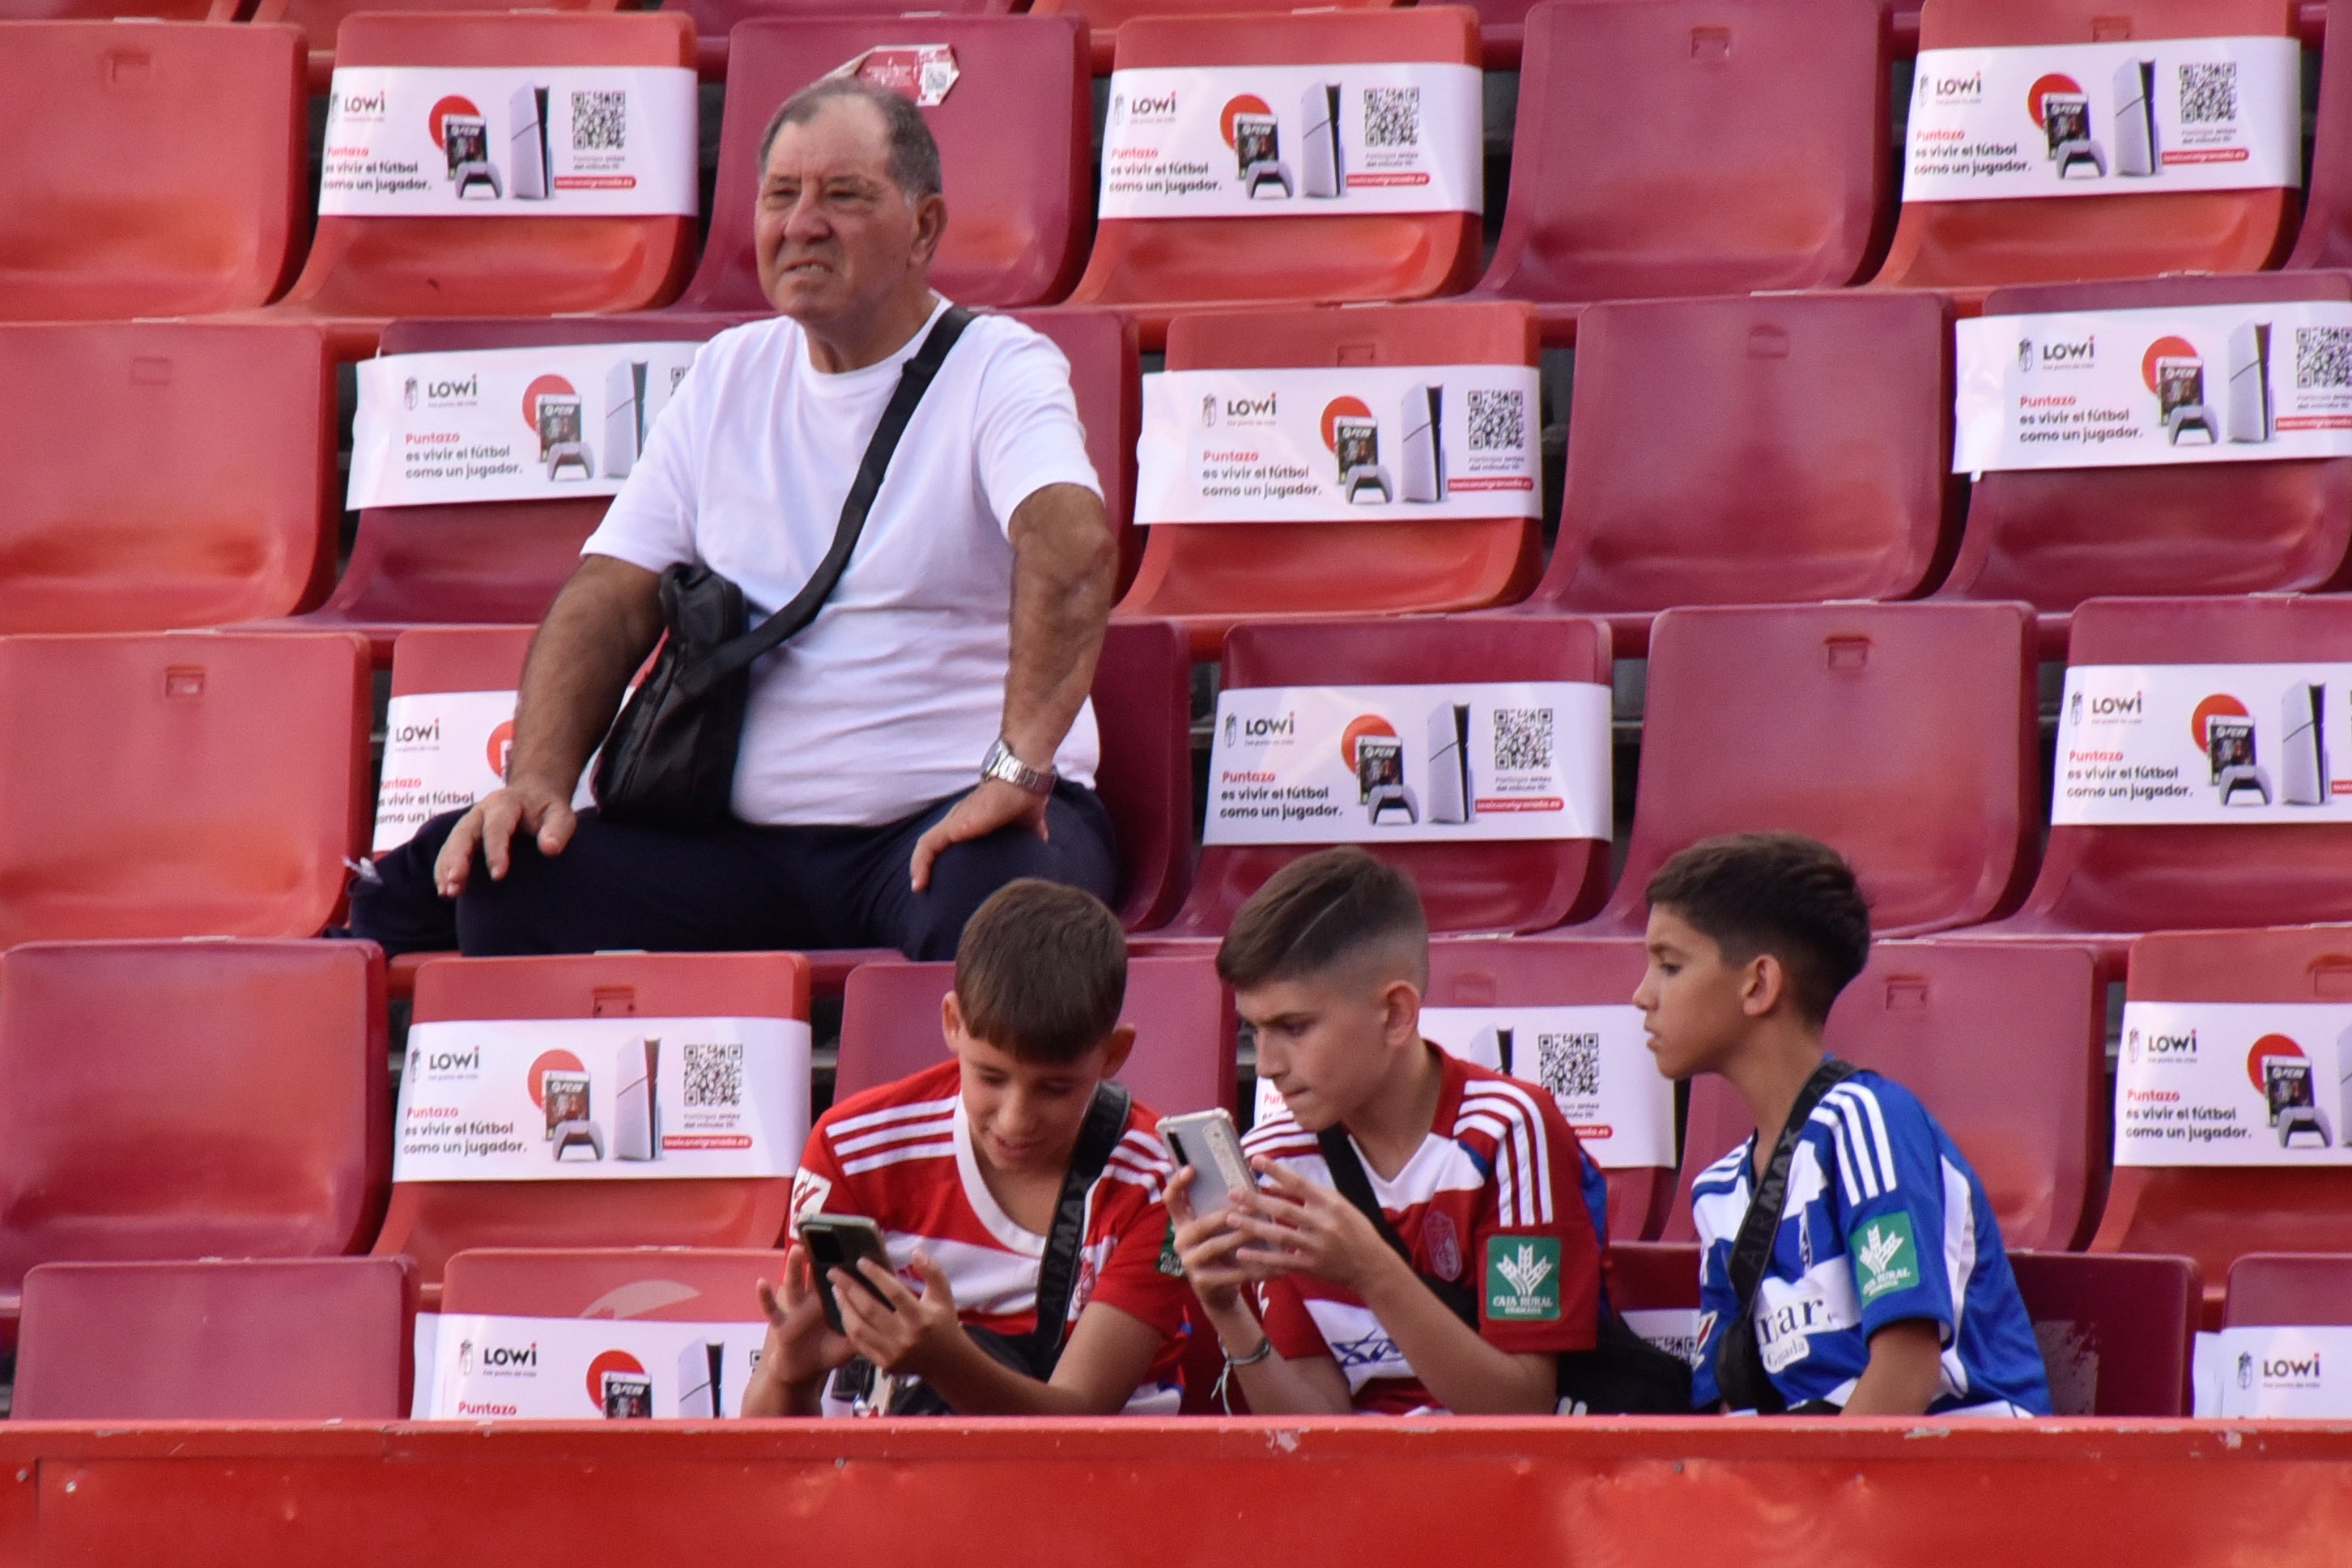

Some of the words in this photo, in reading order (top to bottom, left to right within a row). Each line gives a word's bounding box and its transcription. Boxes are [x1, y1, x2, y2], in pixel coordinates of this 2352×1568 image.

[1916, 130, 1965, 142] Puntazo
[1916, 149, 1927, 158] es
[1930, 145, 1959, 158] vivir
[1962, 144, 1973, 157] el
[1976, 143, 2017, 156] fútbol
[337, 163, 363, 173] vivir
[366, 162, 376, 174] el
[379, 161, 418, 173] fútbol
[1111, 166, 1121, 176] es
[1125, 164, 1152, 175] vivir
[1155, 164, 1166, 176] el
[1169, 163, 1208, 175] fútbol
[1914, 164, 1949, 175] como
[1952, 164, 1970, 173] un
[1972, 159, 2031, 177] jugador.
[356, 180, 372, 190] un
[376, 178, 431, 194] jugador.
[1109, 182, 1142, 192] como
[1146, 181, 1163, 192] un
[1165, 179, 1222, 195] jugador.
[2020, 396, 2077, 408] Puntazo
[2020, 414, 2035, 425] es
[2039, 410, 2069, 424] vivir
[2073, 410, 2084, 423] el
[2087, 408, 2129, 423] fútbol
[406, 432, 460, 444] Puntazo
[2020, 431, 2060, 443] como
[2062, 431, 2081, 440] un
[2082, 426, 2142, 444] jugador.
[406, 452, 420, 462] es
[423, 447, 453, 461] vivir
[456, 447, 467, 460] el
[470, 445, 510, 458] fútbol
[1203, 451, 1259, 462] Puntazo
[406, 468, 443, 478] como
[446, 467, 463, 477] un
[466, 463, 522, 479] jugador.
[1203, 470, 1218, 479] es
[1222, 467, 1252, 479] vivir
[1254, 466, 1266, 479] el
[1269, 465, 1309, 478] fútbol
[1202, 487, 1241, 496] como
[1244, 487, 1261, 496] un
[1263, 482, 1321, 499] jugador.
[2069, 750, 2124, 763] Puntazo
[1223, 771, 1276, 784] Puntazo
[2068, 771, 2082, 780] es
[2086, 766, 2116, 780] vivir
[2120, 767, 2132, 779] el
[2135, 766, 2179, 779] fútbol
[380, 778, 422, 790] untazo
[388, 794, 415, 805] vivir
[418, 792, 430, 805] el
[1222, 791, 1235, 801] es
[1238, 787, 1269, 801] vivir
[1271, 788, 1284, 800] el
[1287, 787, 1329, 800] fútbol
[2067, 788, 2106, 797] como
[2109, 788, 2127, 797] un
[2130, 784, 2193, 801] jugador.
[407, 811, 425, 823] un
[1220, 807, 1258, 818] como
[1261, 807, 1279, 818] un
[1282, 804, 1342, 821] jugador.
[2128, 1089, 2180, 1103] Puntazo
[406, 1107, 458, 1120] Puntazo
[2126, 1109, 2139, 1120] es
[2142, 1106, 2174, 1120] vivir
[2176, 1107, 2189, 1120] el
[2192, 1107, 2236, 1120] fútbol
[405, 1127, 417, 1137] es
[421, 1123, 451, 1136] vivir
[454, 1122, 466, 1135] el
[470, 1122, 513, 1135] fútbol
[2126, 1128, 2163, 1138] como
[2167, 1128, 2185, 1138] un
[2188, 1124, 2252, 1142] jugador.
[403, 1144, 440, 1154] como
[443, 1143, 461, 1154] un
[464, 1139, 527, 1157] jugador.
[1759, 1126, 1801, 1212] MAX
[459, 1401, 517, 1416] Puntazo
